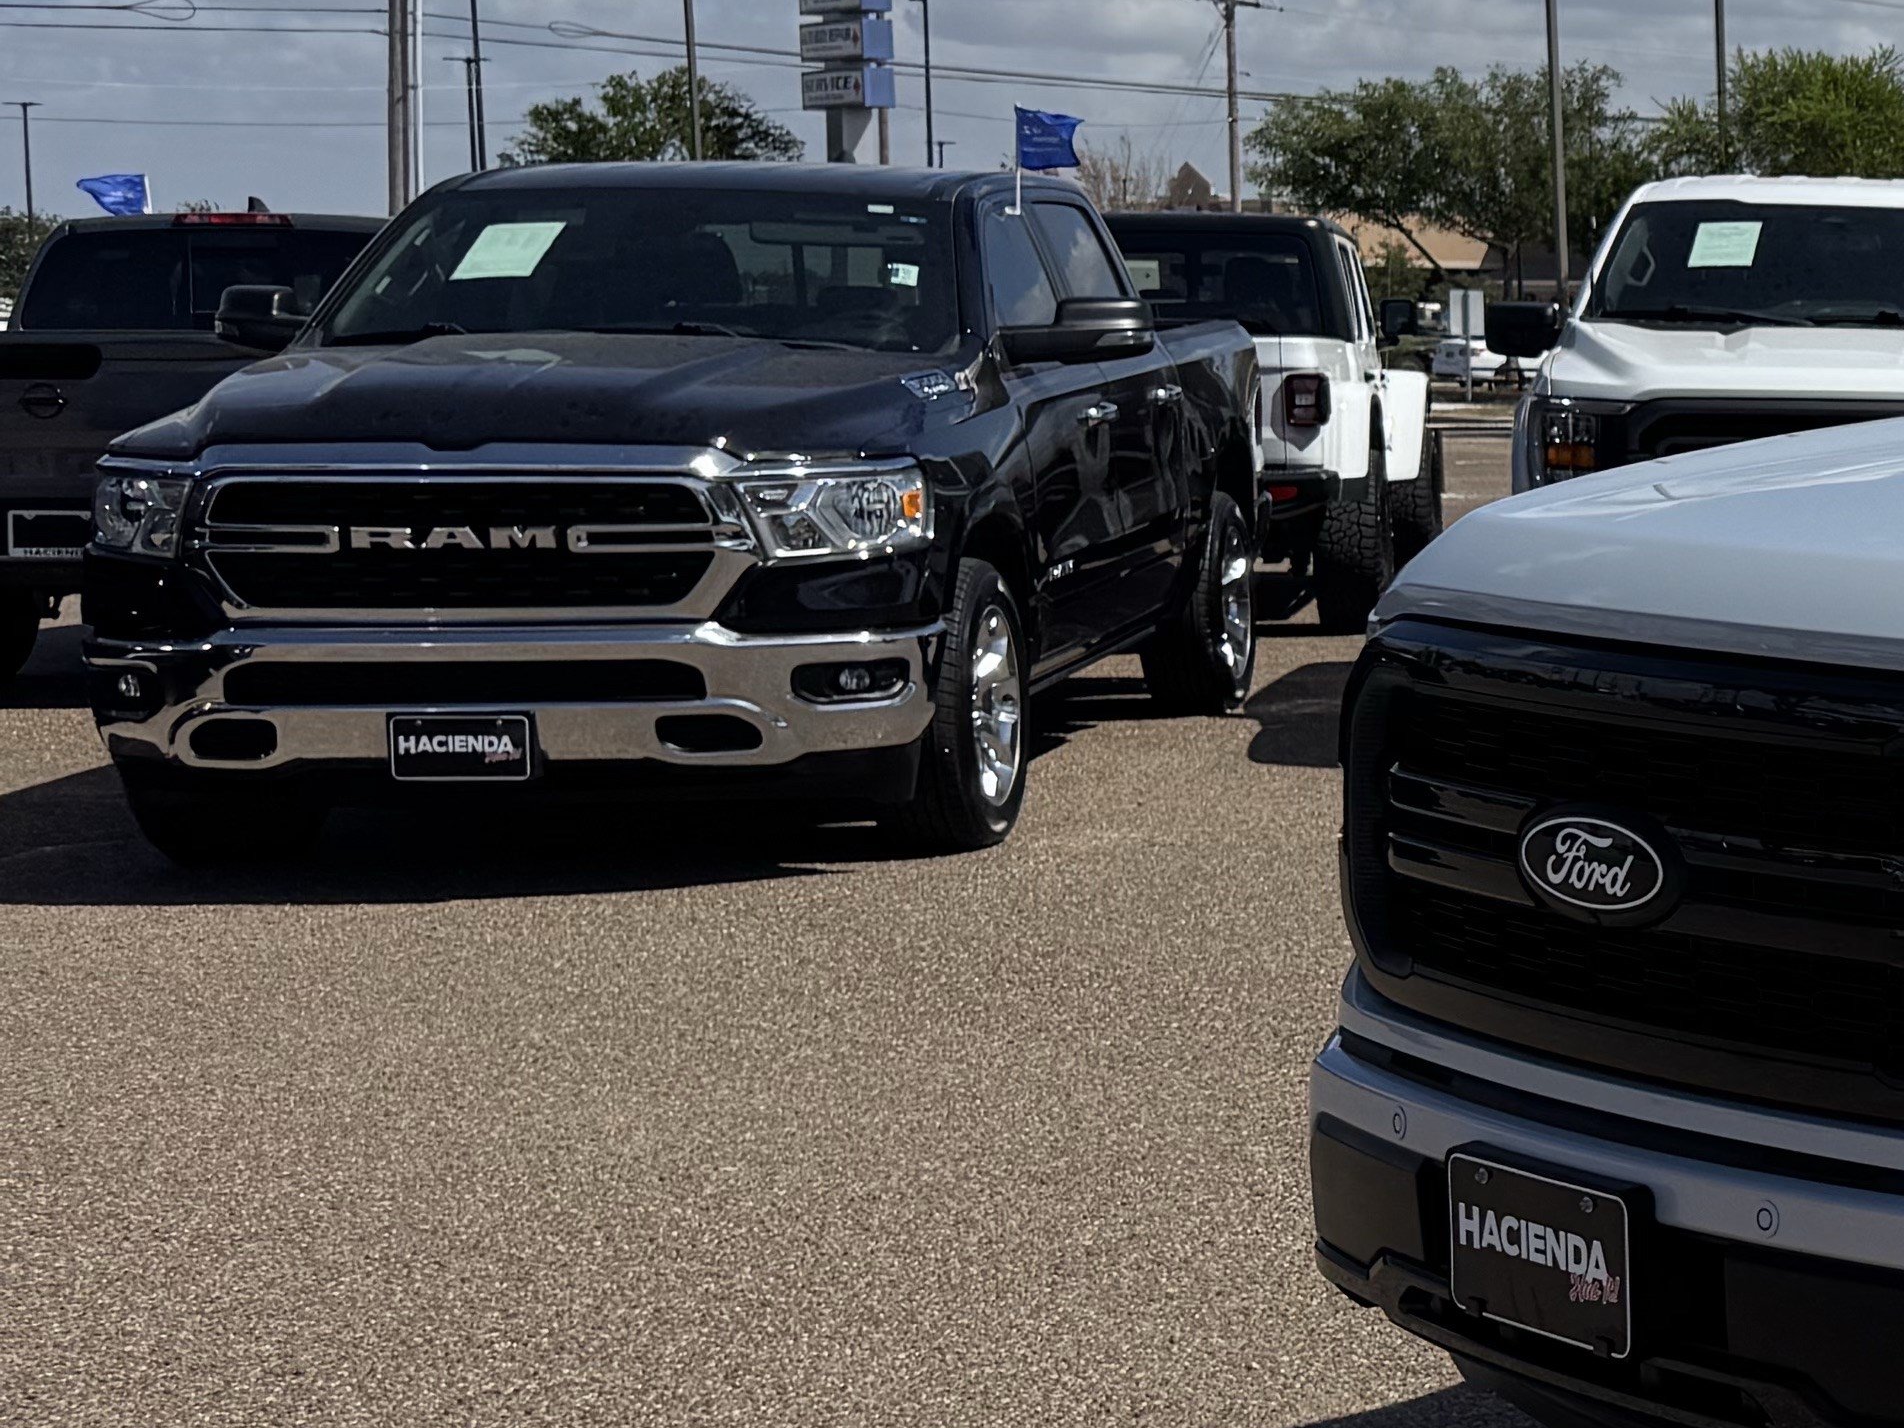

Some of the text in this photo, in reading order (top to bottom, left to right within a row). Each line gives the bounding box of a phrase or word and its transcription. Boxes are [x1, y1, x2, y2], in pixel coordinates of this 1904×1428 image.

[804, 75, 852, 93] SERVICE
[350, 525, 557, 550] RAM
[398, 734, 514, 756] HACIENDA
[1546, 827, 1634, 897] Ford
[1458, 1202, 1608, 1284] HACIENDA
